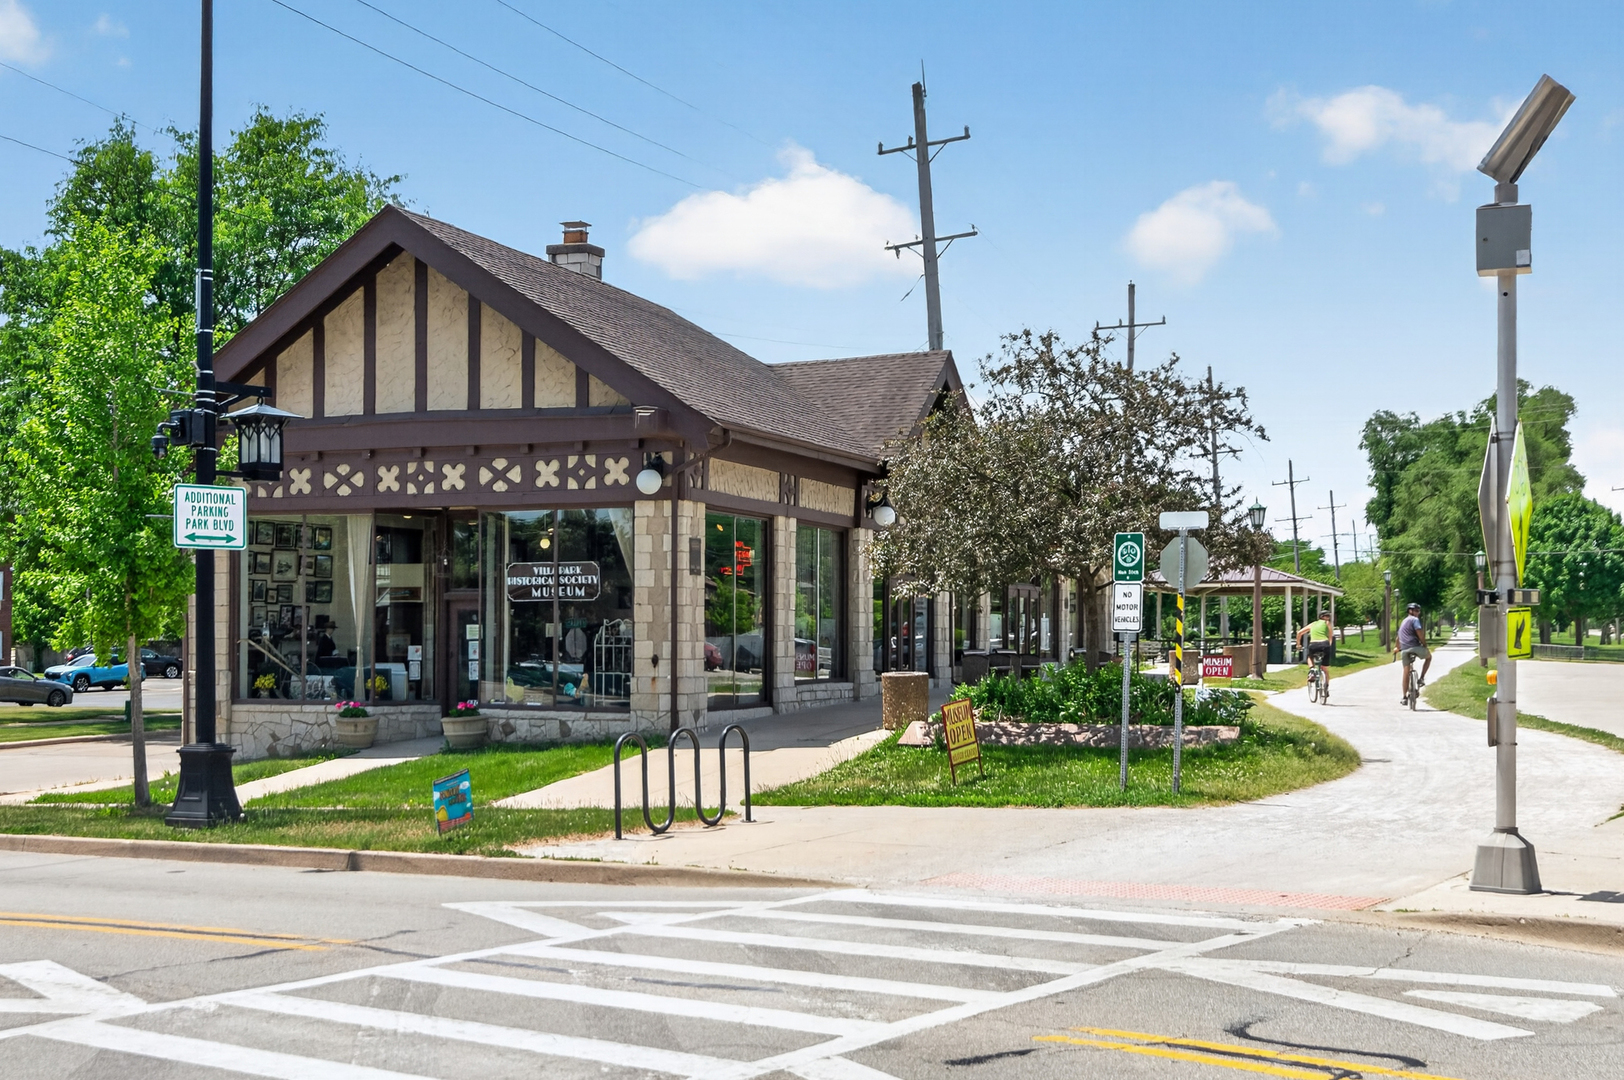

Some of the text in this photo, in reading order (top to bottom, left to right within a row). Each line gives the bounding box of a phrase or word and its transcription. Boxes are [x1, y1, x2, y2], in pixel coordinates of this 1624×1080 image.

[184, 491, 236, 505] ADDITIONAL
[191, 505, 229, 518] PARKING
[185, 518, 234, 531] PARK BLVD
[558, 566, 582, 575] PARK
[559, 575, 599, 585] SOCIETY
[531, 586, 585, 597] MUSEUM
[1116, 603, 1138, 611] MOTOR
[1114, 615, 1139, 623] VEHICLES
[1203, 657, 1232, 667] MUSEUM
[1205, 666, 1229, 676] OPEN
[946, 703, 972, 725] MUSEUM
[949, 722, 973, 745] OPEN
